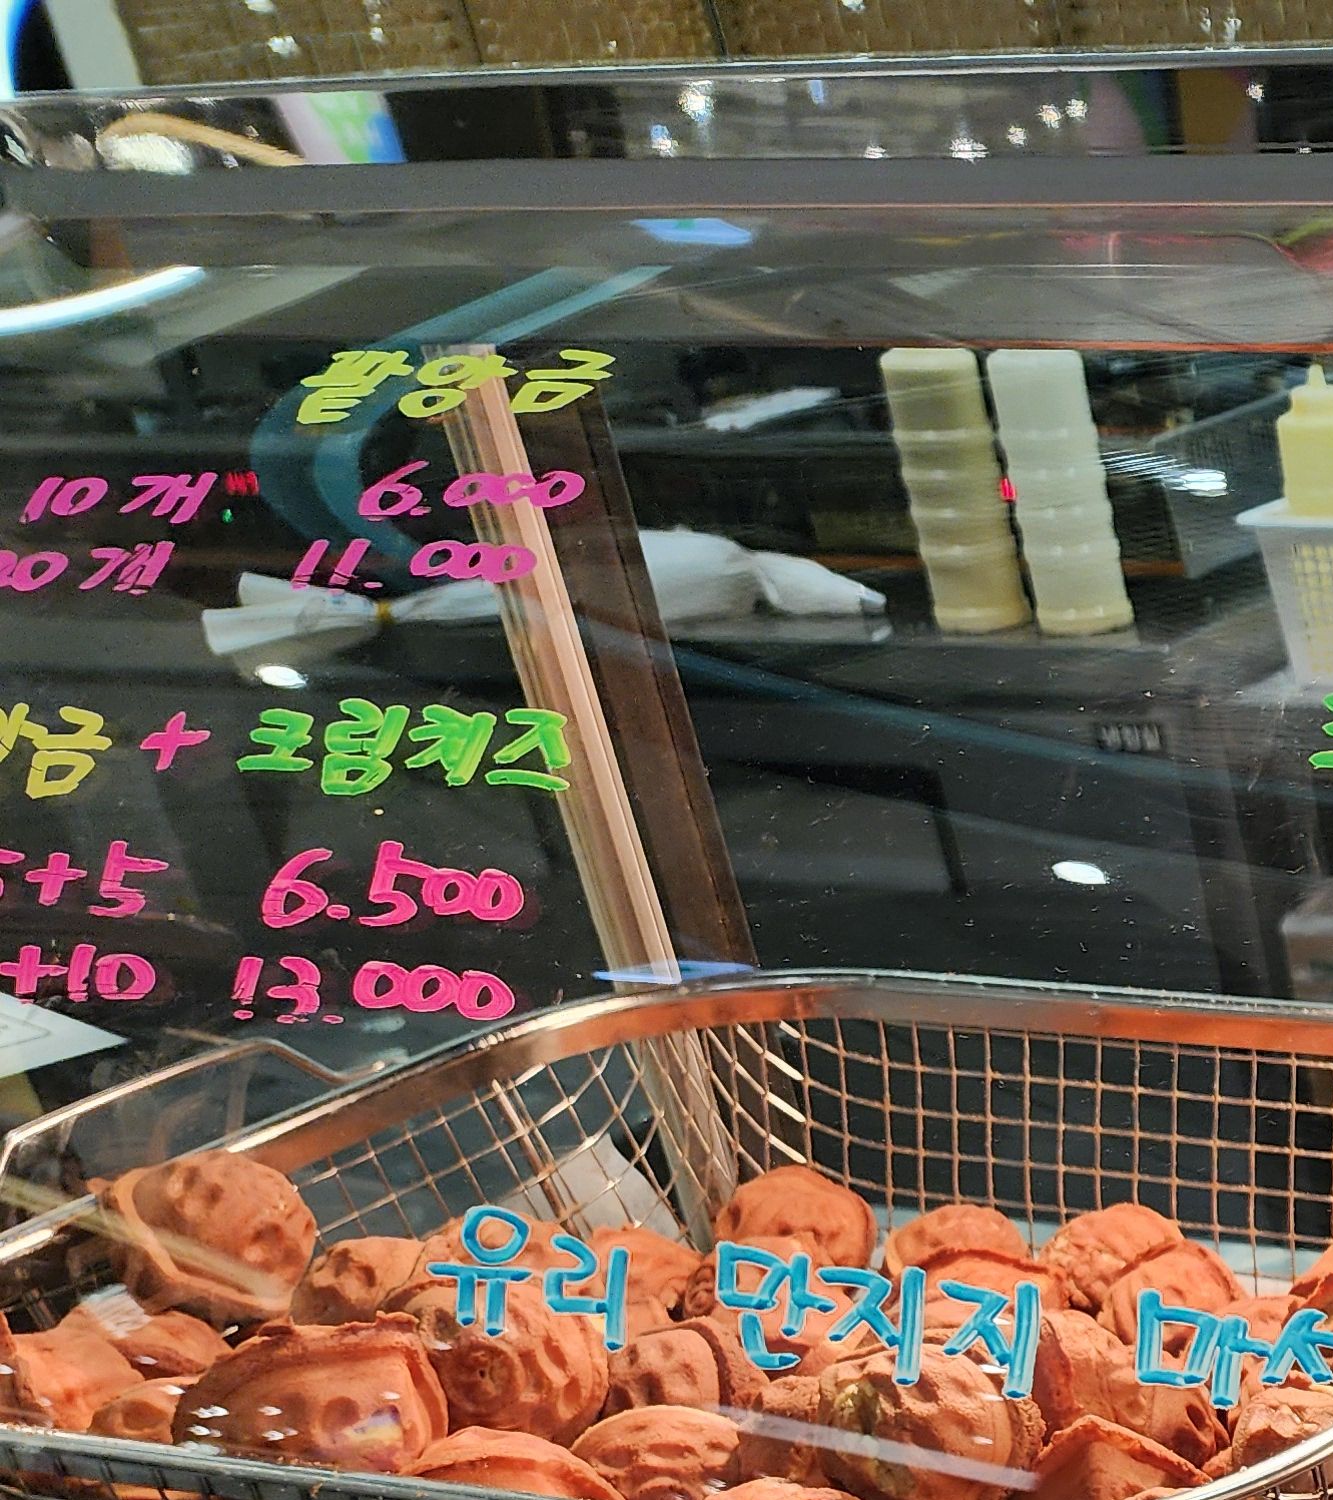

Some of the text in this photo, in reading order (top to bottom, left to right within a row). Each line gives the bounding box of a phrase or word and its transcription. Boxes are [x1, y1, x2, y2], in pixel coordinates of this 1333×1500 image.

[356, 459, 587, 517] 6.000
[289, 538, 539, 591] 11.000
[235, 699, 571, 796] 크림치즈
[259, 839, 526, 928] 6.500
[231, 954, 515, 1025] 13.000
[429, 1207, 629, 1351] 유리
[717, 1243, 1039, 1400] 만지지
